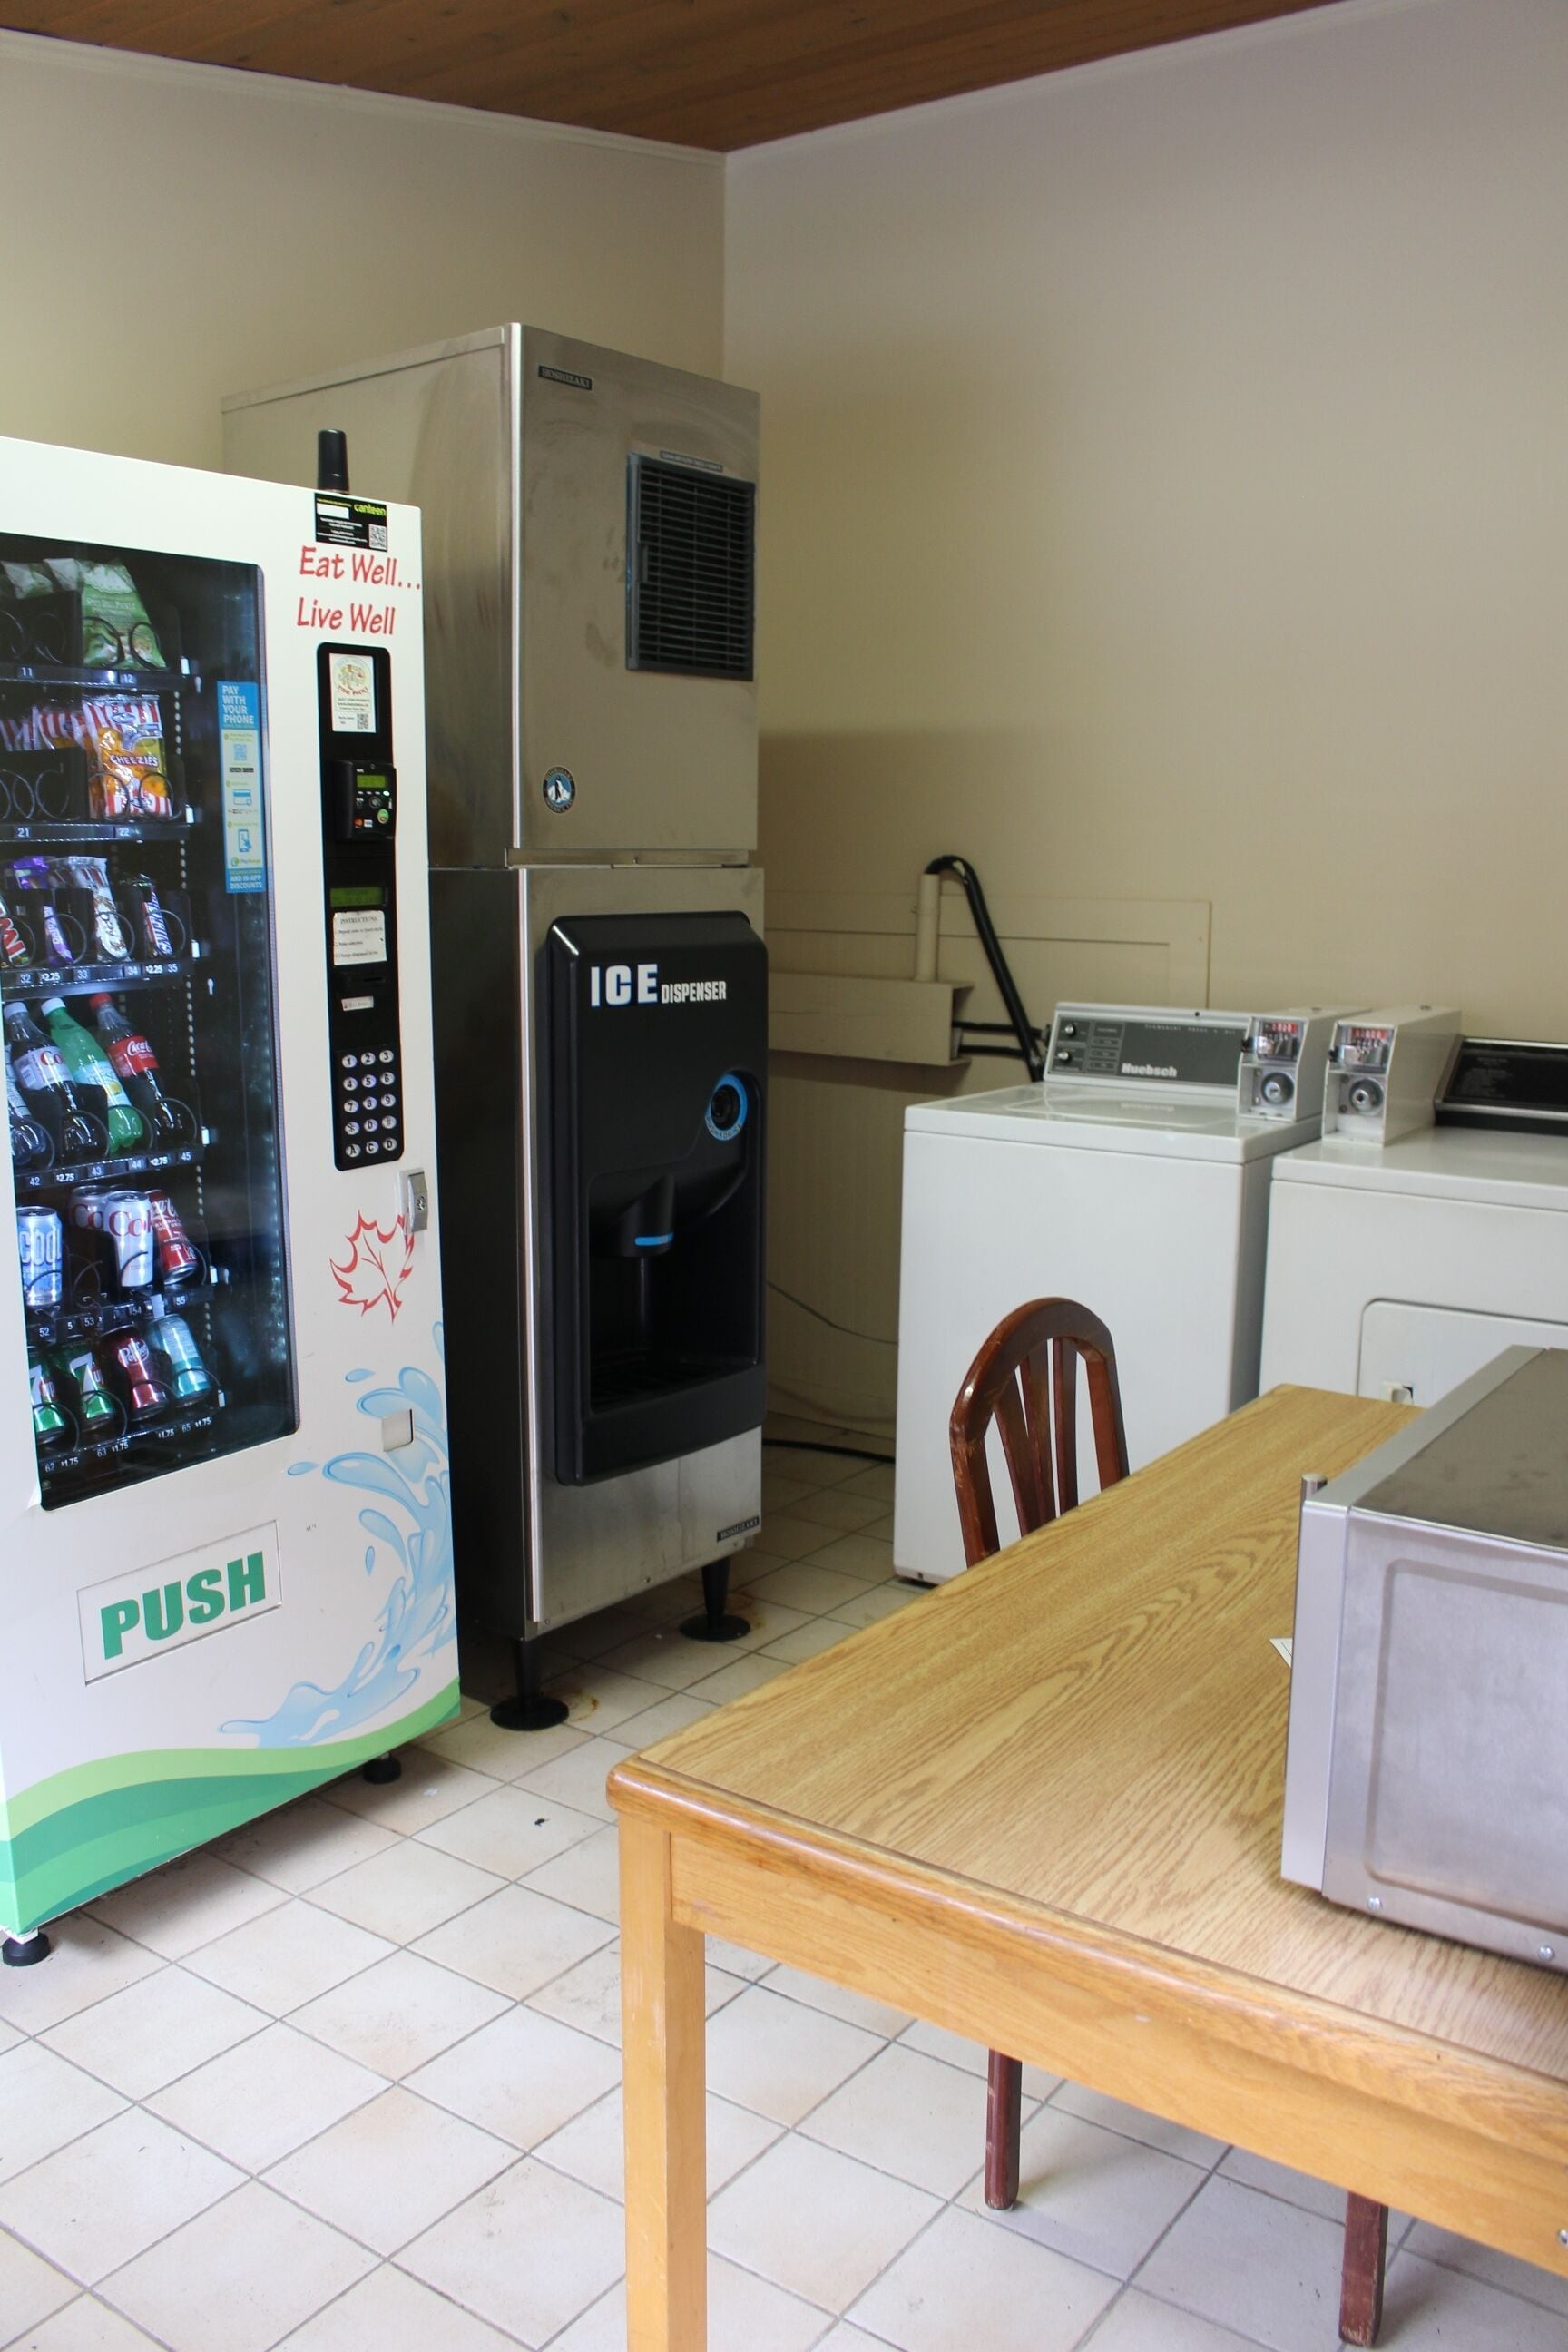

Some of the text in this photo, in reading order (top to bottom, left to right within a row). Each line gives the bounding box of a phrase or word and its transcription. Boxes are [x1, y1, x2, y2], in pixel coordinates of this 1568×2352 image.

[354, 504, 387, 516] canteen
[299, 545, 420, 590] Eat Well...
[297, 597, 396, 635] Live Well
[21, 667, 34, 676] 11
[122, 674, 133, 683] 12
[222, 685, 239, 694] PAY
[222, 695, 246, 705] WITH
[222, 704, 248, 714] YOUR
[223, 714, 254, 724] PHONE
[109, 755, 159, 767] CHEEZIES
[17, 828, 30, 837] 21
[118, 828, 130, 836] 22
[340, 916, 377, 925] INSTRUCTIONS
[20, 975, 31, 984] 32
[77, 970, 88, 979] 33
[127, 966, 138, 975] 34
[168, 963, 178, 973] 35
[591, 964, 726, 1007] ICE DISPENSER
[1121, 1063, 1178, 1078] Huebsch
[29, 1177, 41, 1186] 42
[92, 1167, 103, 1176] 43
[132, 1160, 142, 1169] 44
[181, 1152, 191, 1161] 45
[39, 1328, 50, 1338] 52
[84, 1318, 94, 1326] 53
[176, 1296, 186, 1305] 55
[45, 1463, 55, 1472] 62
[97, 1448, 106, 1458] 63
[181, 1423, 191, 1432] 65
[101, 1551, 266, 1660] PUSH
